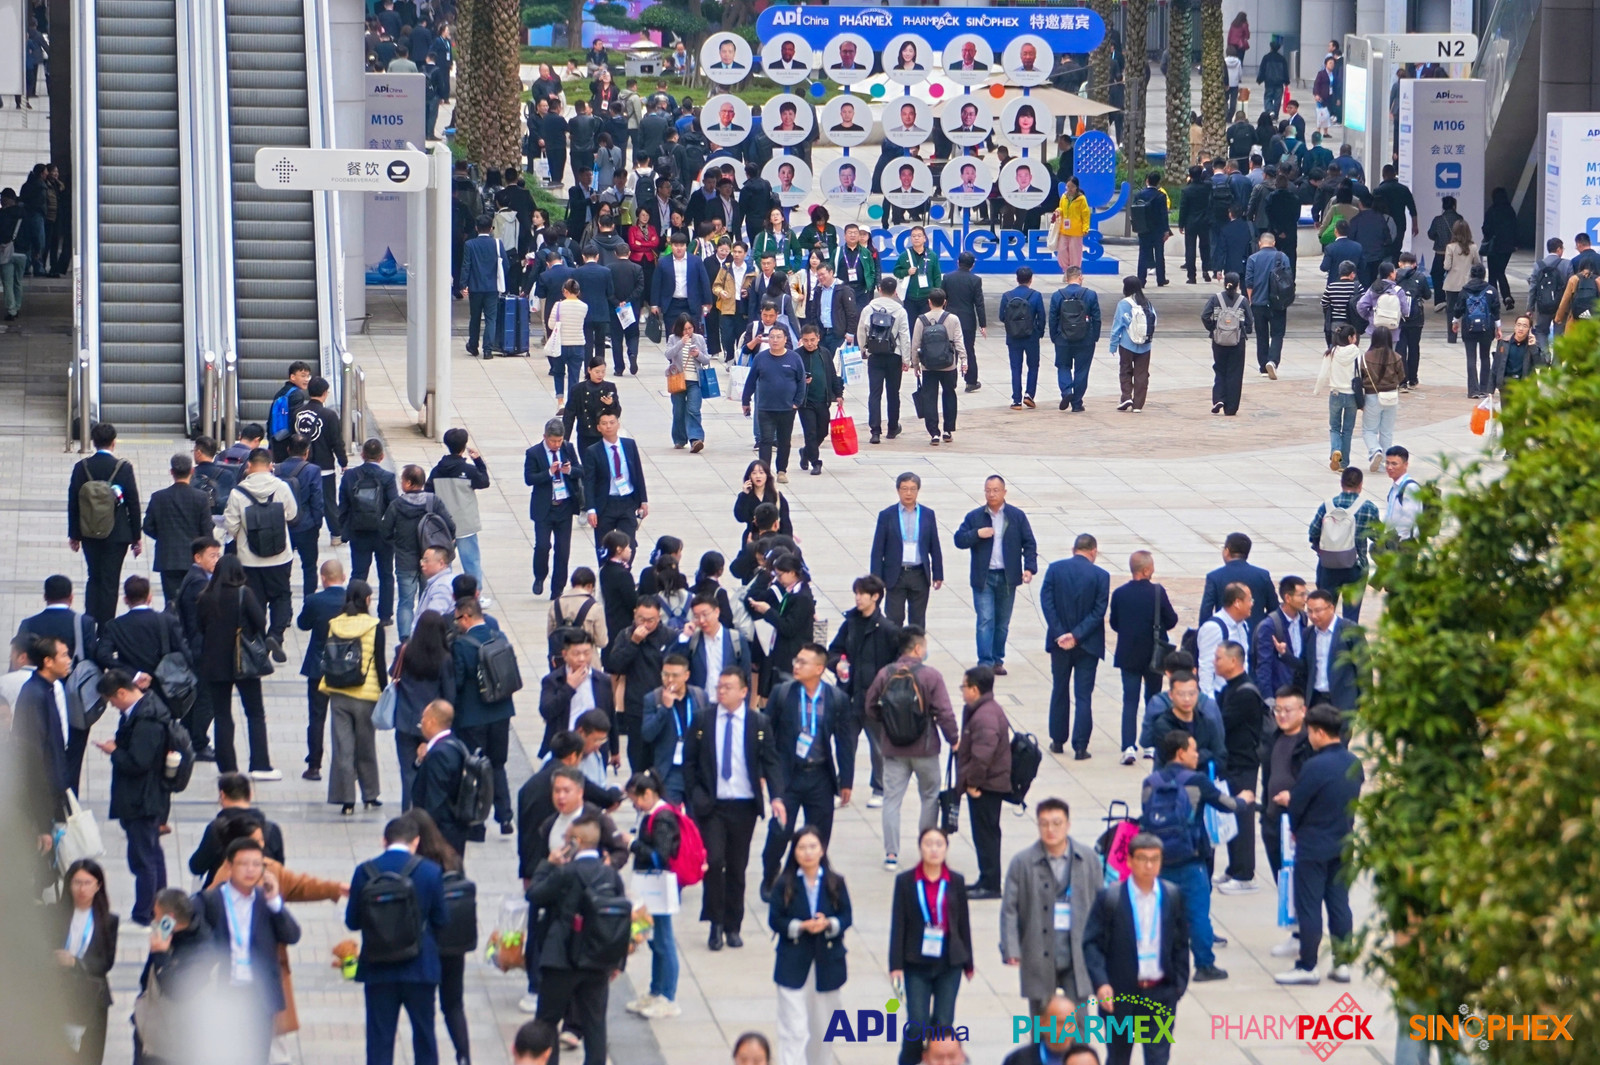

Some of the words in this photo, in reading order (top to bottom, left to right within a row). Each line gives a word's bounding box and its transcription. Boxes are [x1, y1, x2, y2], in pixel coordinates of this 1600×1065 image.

[803, 15, 829, 26] China
[839, 15, 893, 27] PHARMEX
[903, 15, 960, 27] PHARMPACK
[966, 15, 1019, 28] SINOPHEX
[1030, 13, 1090, 30] 特邀嘉宾
[1438, 40, 1465, 57] N2
[371, 115, 404, 126] M105
[1433, 120, 1465, 131] M106
[369, 138, 405, 149] 会议室
[1431, 144, 1466, 155] 会议室
[347, 161, 380, 176] 餐饮
